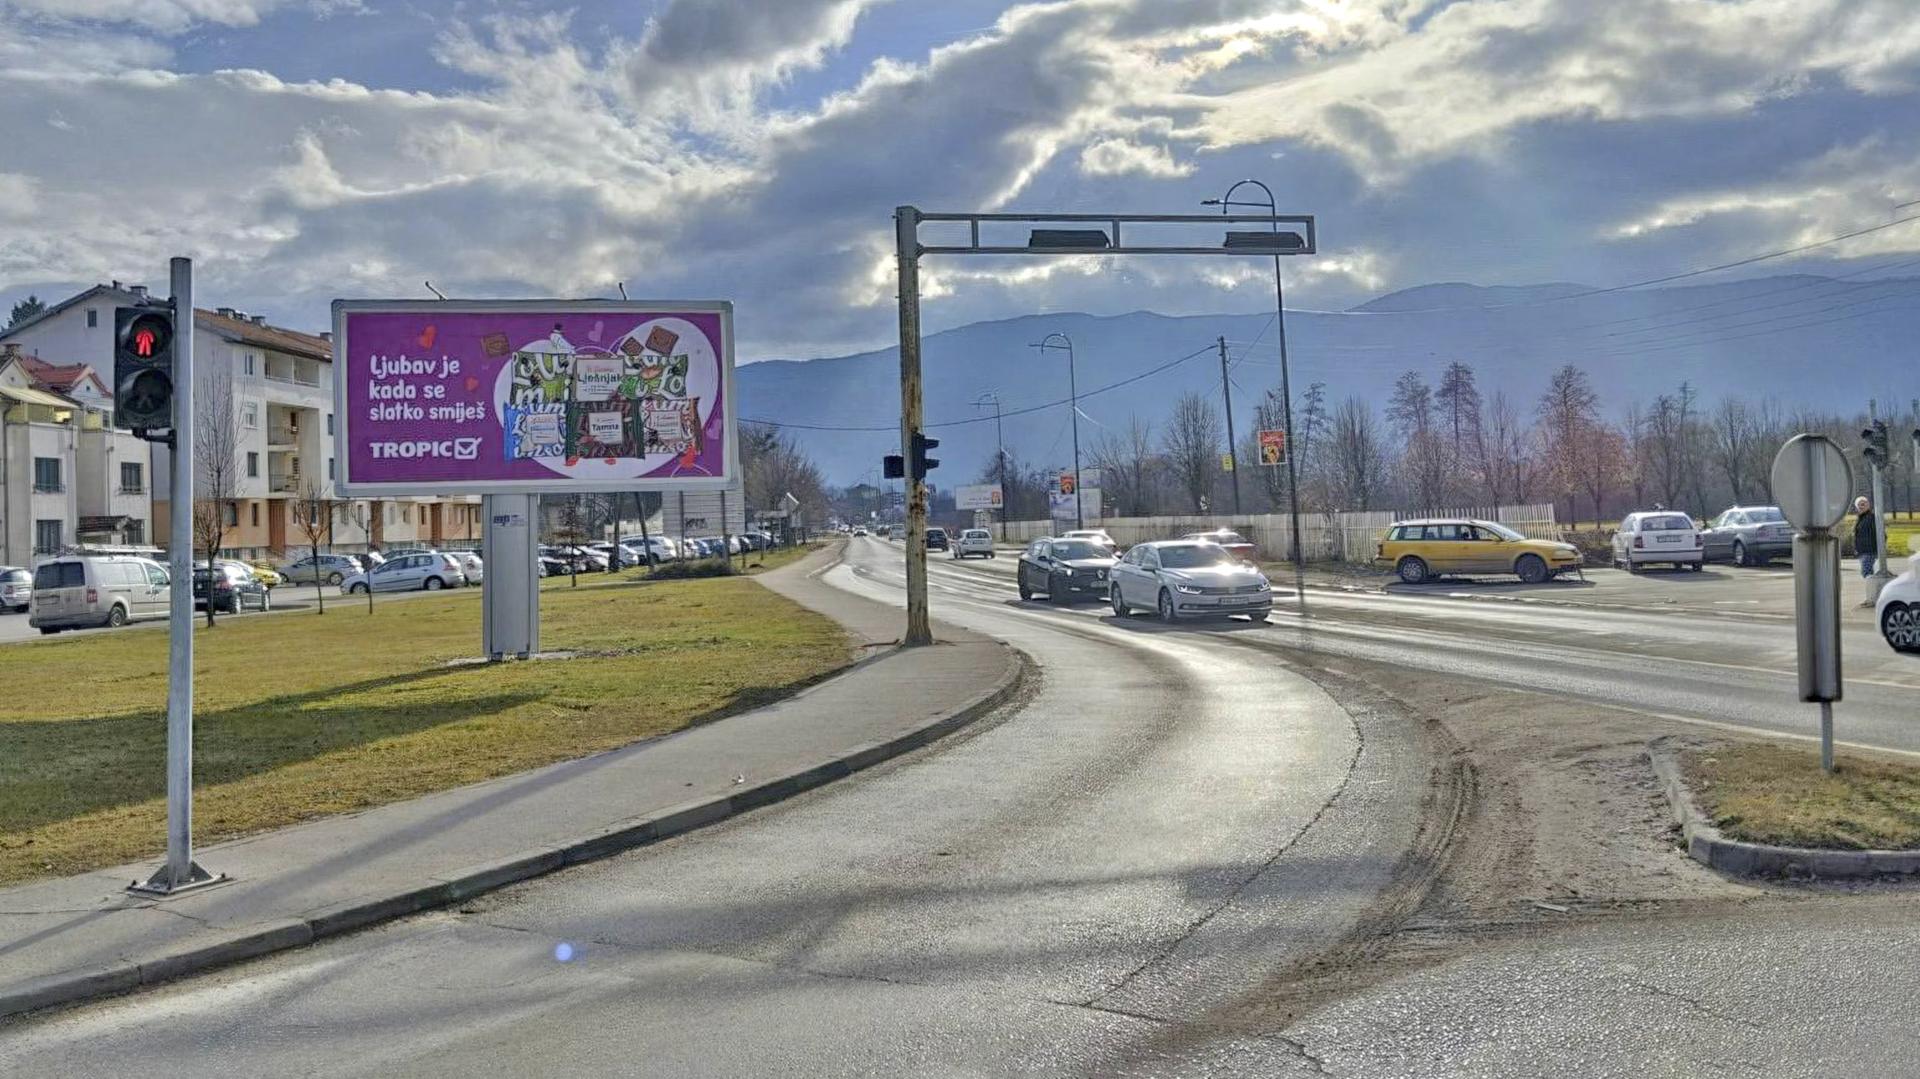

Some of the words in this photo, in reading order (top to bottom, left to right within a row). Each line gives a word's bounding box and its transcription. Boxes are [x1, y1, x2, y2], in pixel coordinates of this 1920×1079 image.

[370, 354, 437, 379] Ljubav
[438, 355, 460, 379] je
[369, 379, 417, 400] kada
[423, 384, 446, 399] se
[369, 402, 424, 421] slatko
[429, 401, 486, 423] smiješ
[369, 441, 453, 458] TROPIC
